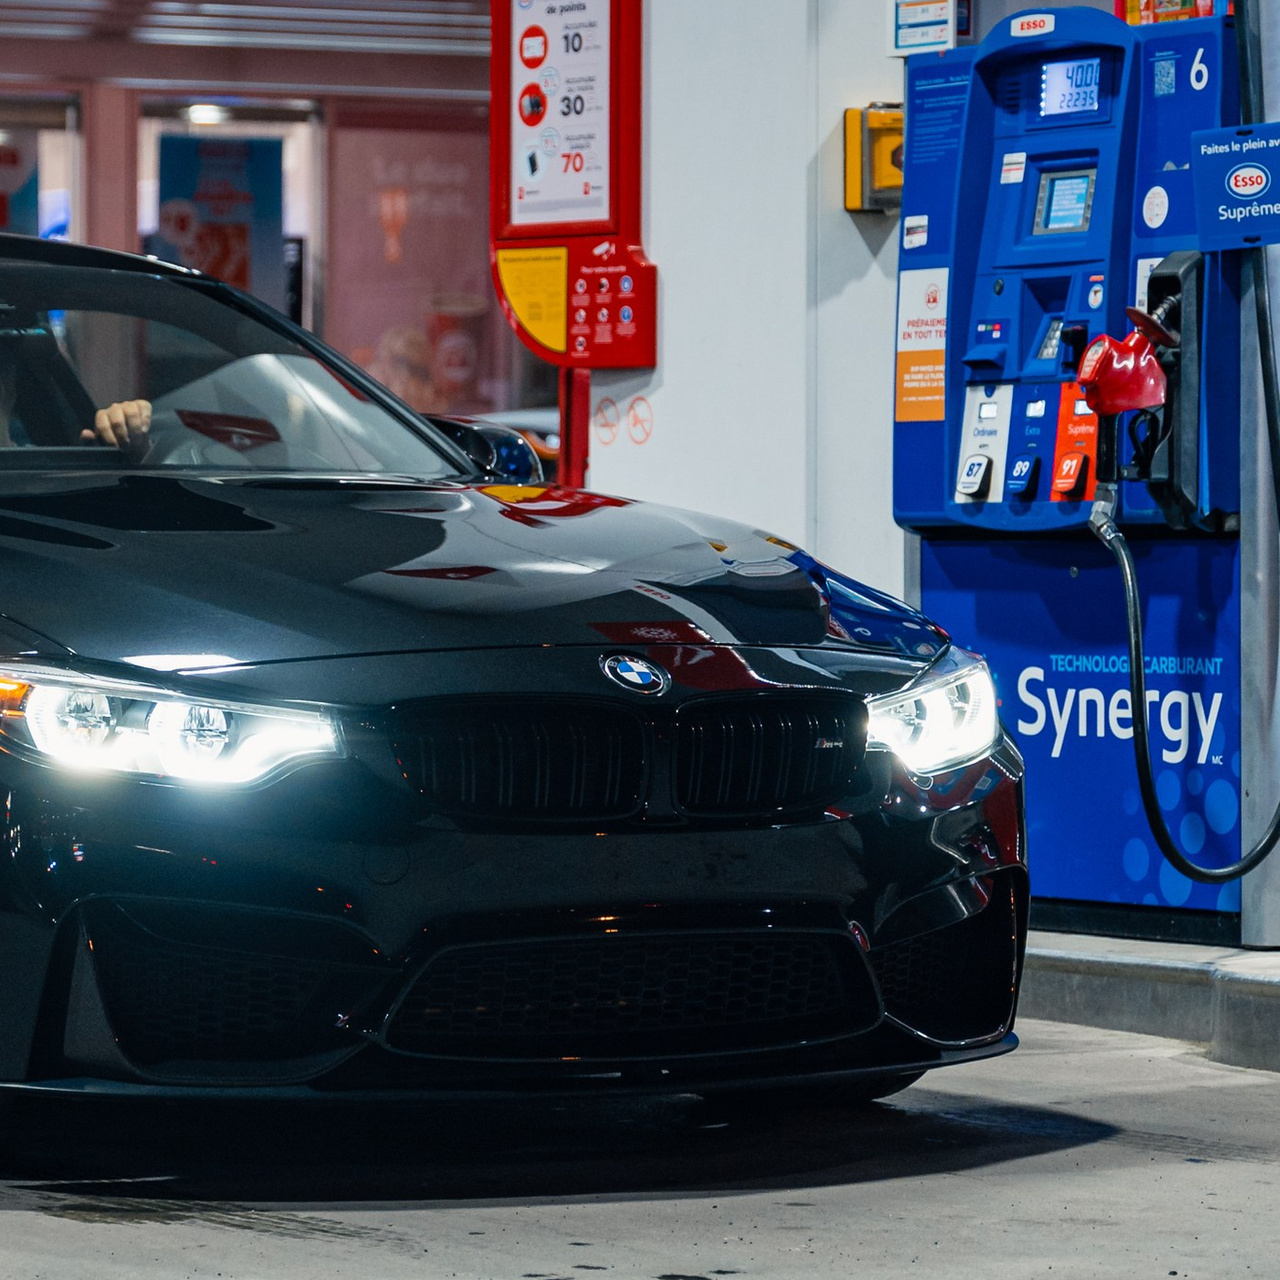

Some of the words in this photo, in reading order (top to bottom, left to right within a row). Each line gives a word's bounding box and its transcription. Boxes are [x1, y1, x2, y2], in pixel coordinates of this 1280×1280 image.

[1020, 19, 1046, 31] ESSO
[562, 32, 582, 53] 10
[1190, 47, 1209, 91] 6
[560, 94, 585, 116] 30
[1201, 143, 1229, 155] Faites
[1231, 141, 1241, 151] le
[1243, 138, 1267, 152] plein
[561, 152, 584, 173] 70
[1233, 173, 1264, 188] Esso
[1218, 201, 1280, 222] Suprême
[903, 331, 912, 340] EN
[914, 330, 932, 340] TOUT
[935, 329, 946, 338] TE
[1025, 425, 1041, 436] Extra
[1067, 423, 1096, 436] Suprême
[966, 463, 983, 477] 87
[1012, 461, 1030, 477] 89
[1062, 459, 1078, 476] 91
[1050, 655, 1131, 672] TECHNOLOG
[1211, 755, 1223, 765] MC
